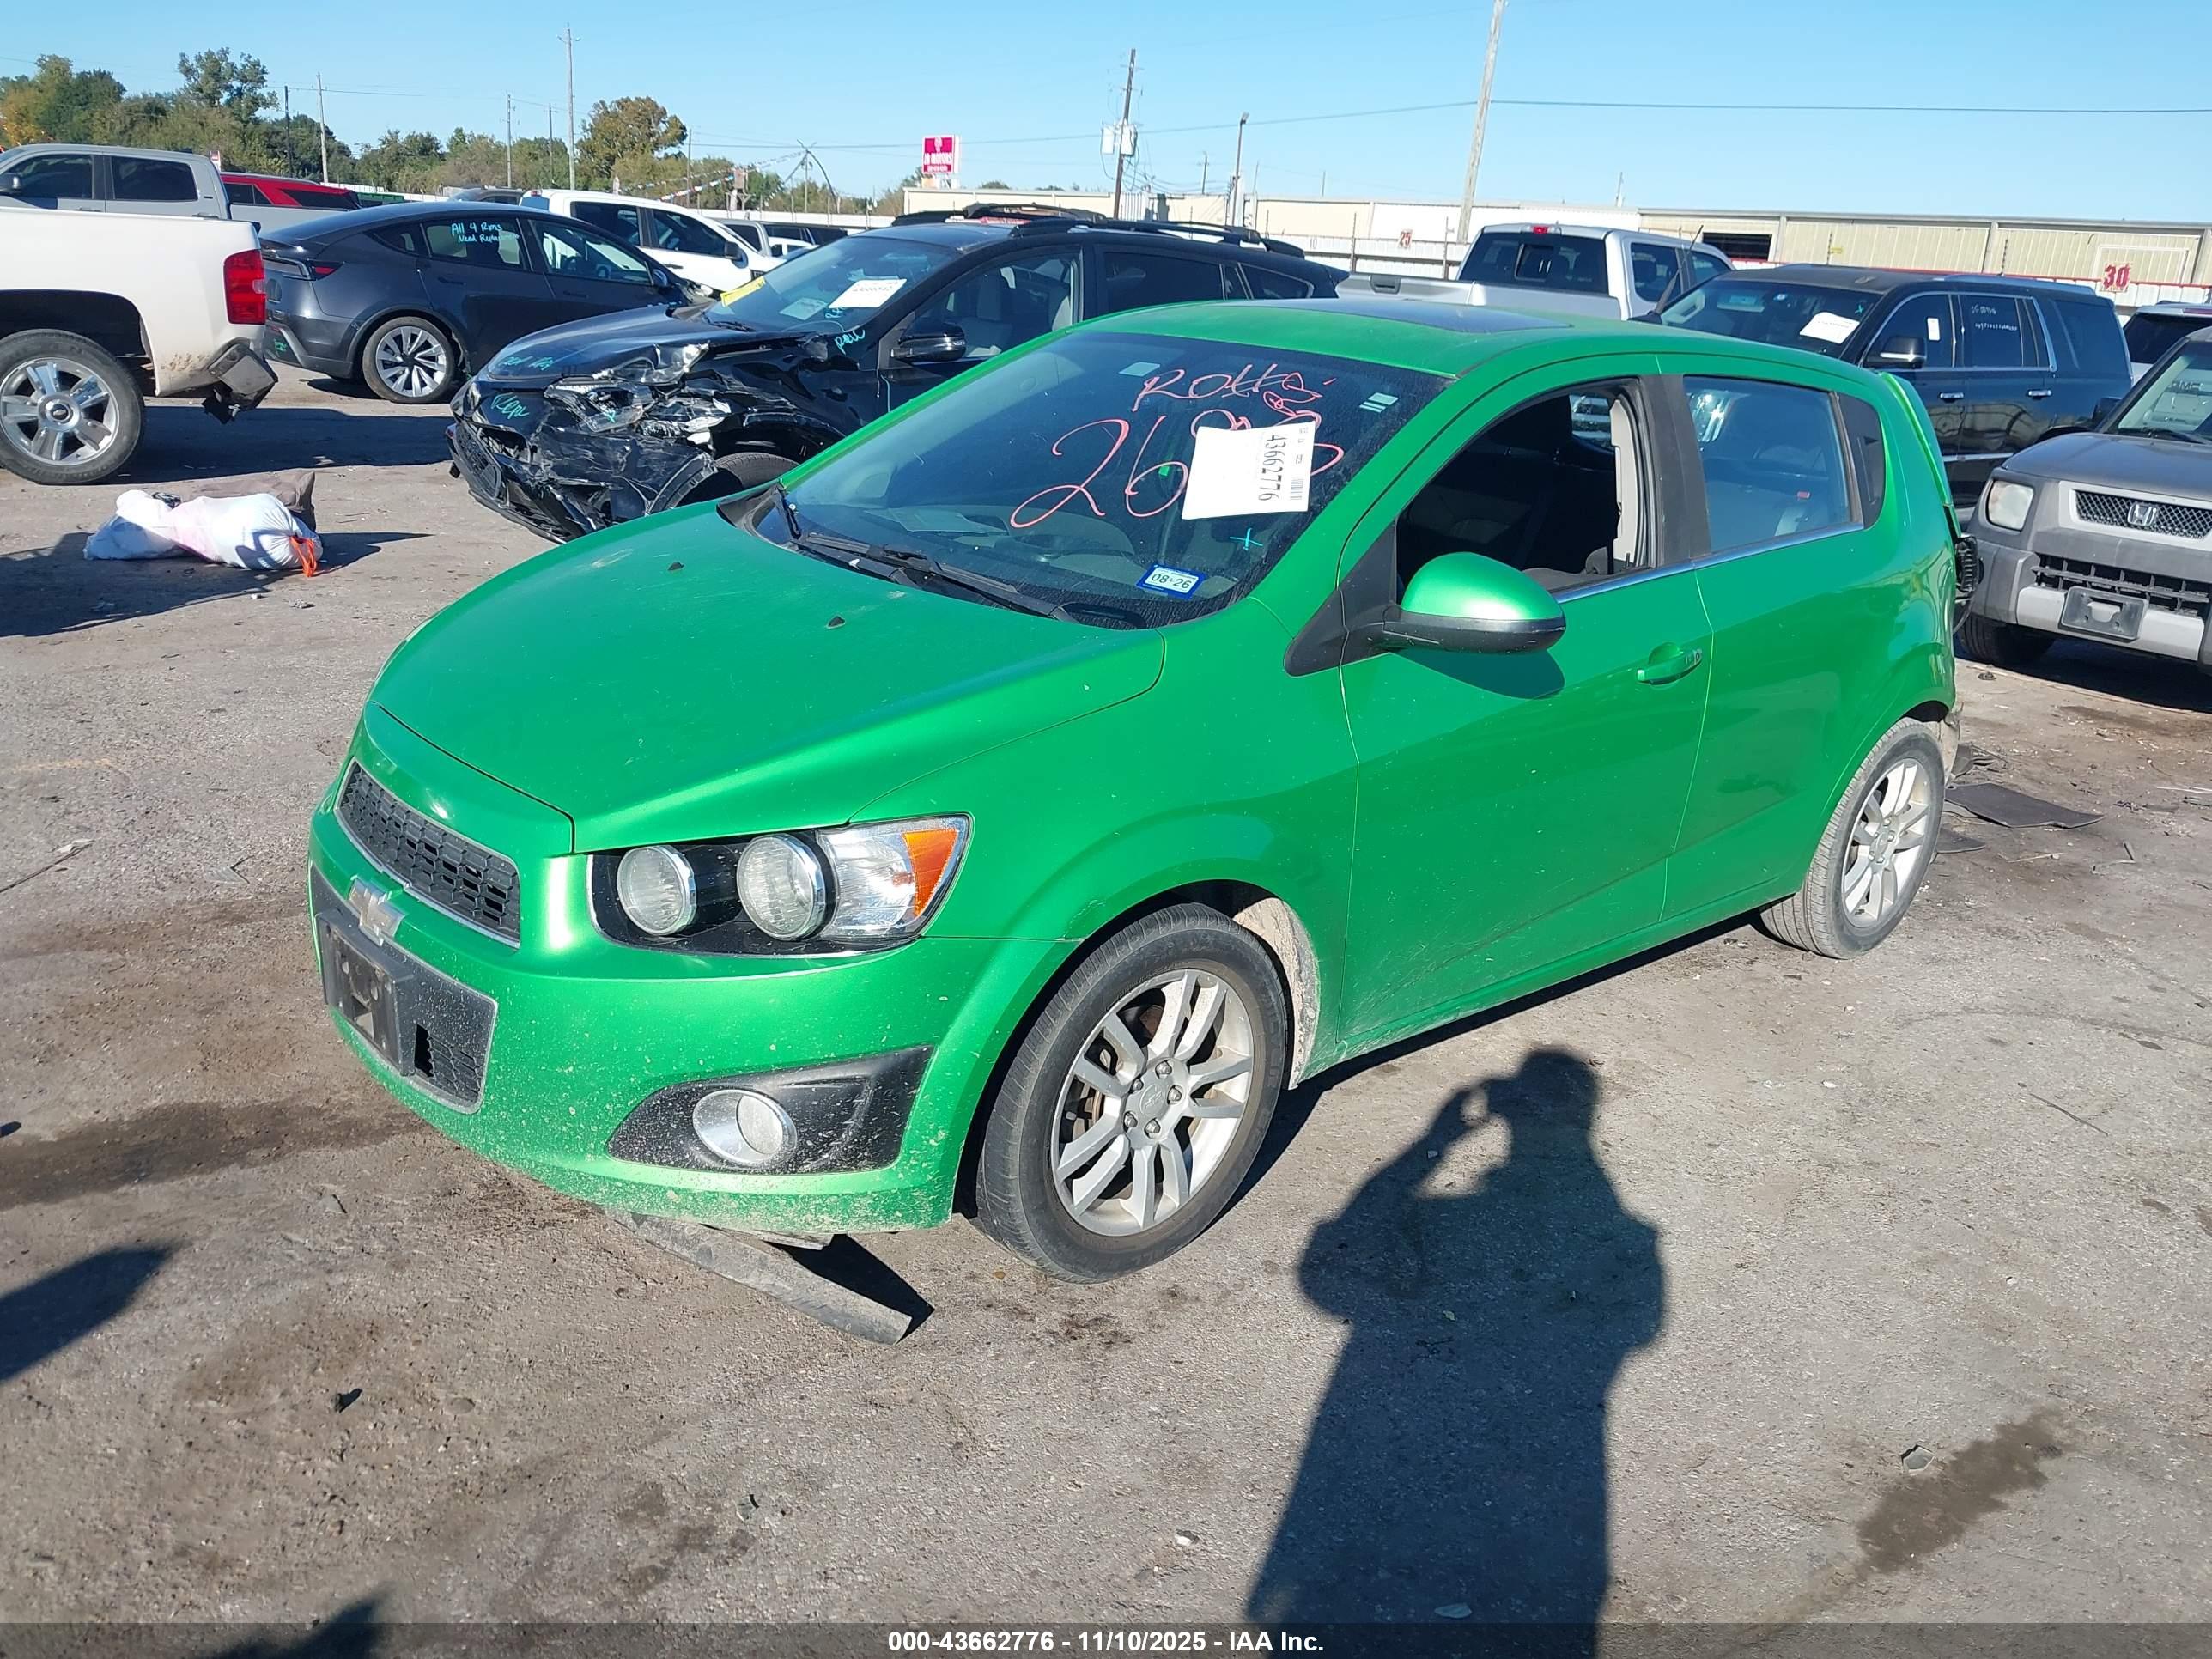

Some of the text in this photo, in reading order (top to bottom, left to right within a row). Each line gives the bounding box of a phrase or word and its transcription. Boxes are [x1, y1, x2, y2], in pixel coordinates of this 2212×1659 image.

[451, 222, 465, 236] All
[469, 222, 477, 233] 4
[2104, 265, 2130, 289] 30
[1258, 434, 1287, 501] 43662776
